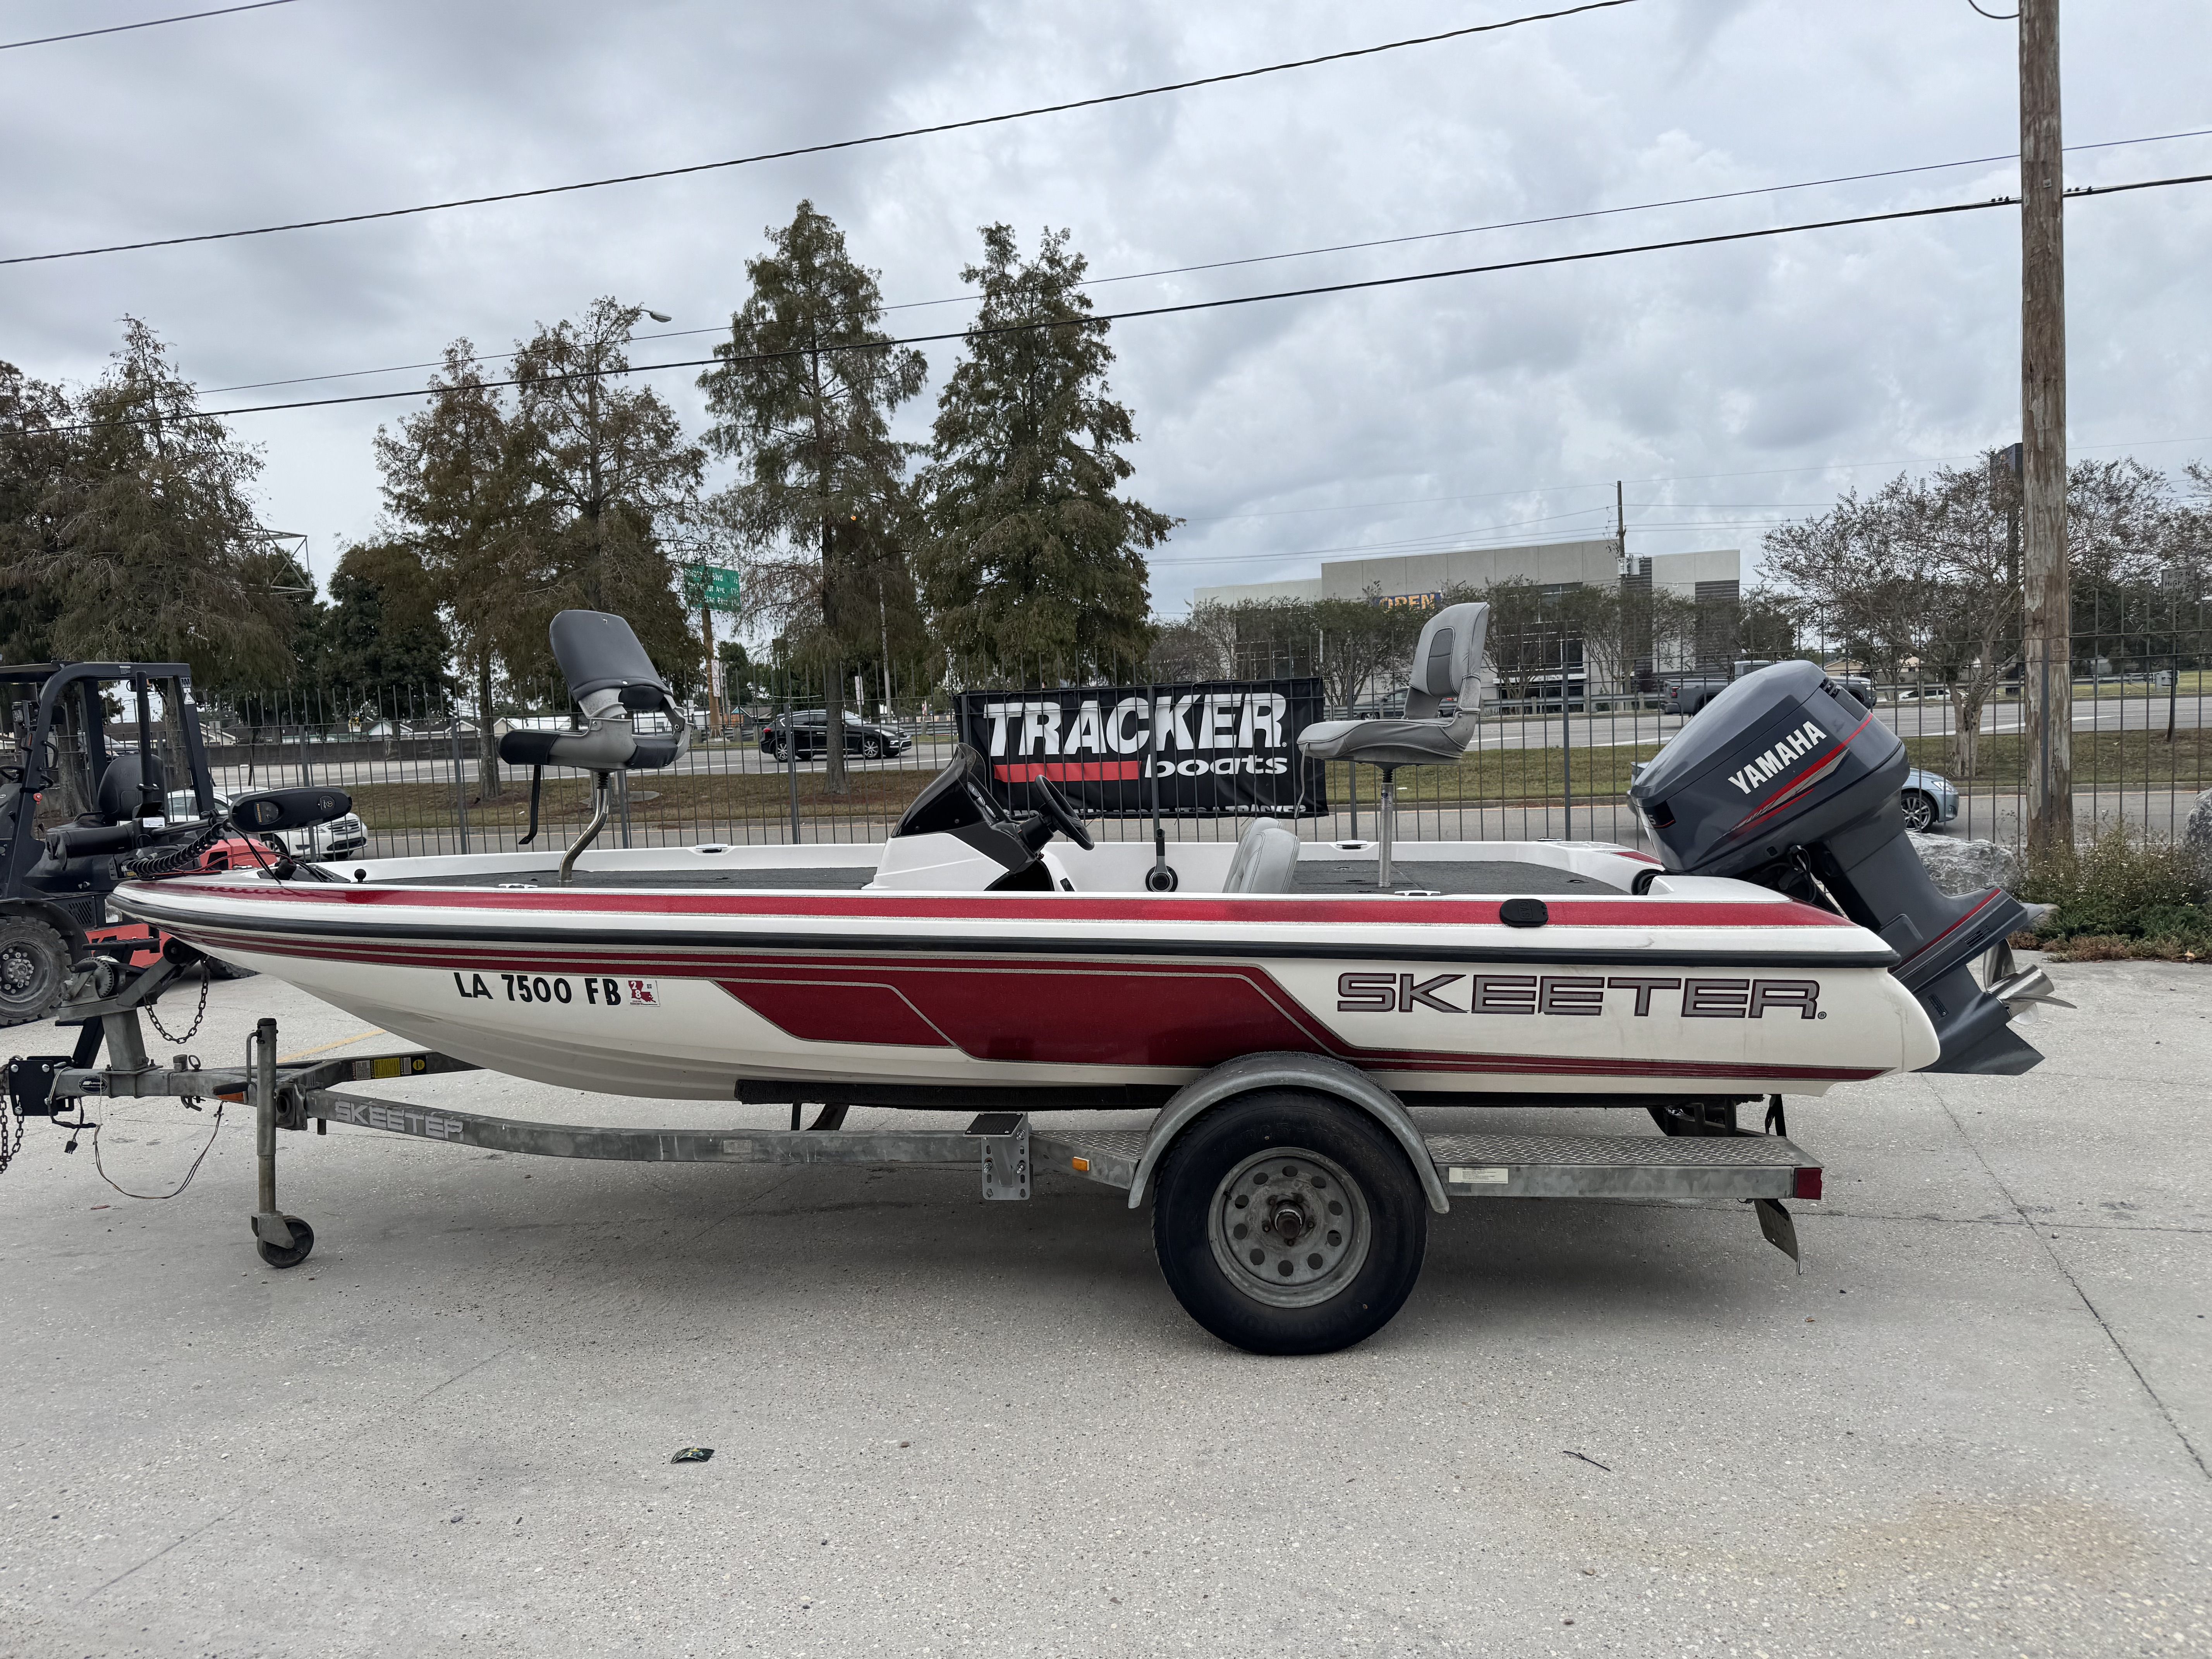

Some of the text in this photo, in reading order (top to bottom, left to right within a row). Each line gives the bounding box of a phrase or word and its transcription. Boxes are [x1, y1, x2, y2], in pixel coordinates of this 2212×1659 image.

[1379, 594, 1435, 613] OPEN
[983, 693, 1286, 756] TRACKER
[1145, 754, 1288, 778] boats
[1728, 721, 1827, 794] YAMAHA
[453, 972, 621, 1006] LA 7500 FB
[1337, 972, 1820, 1019] SKEETER
